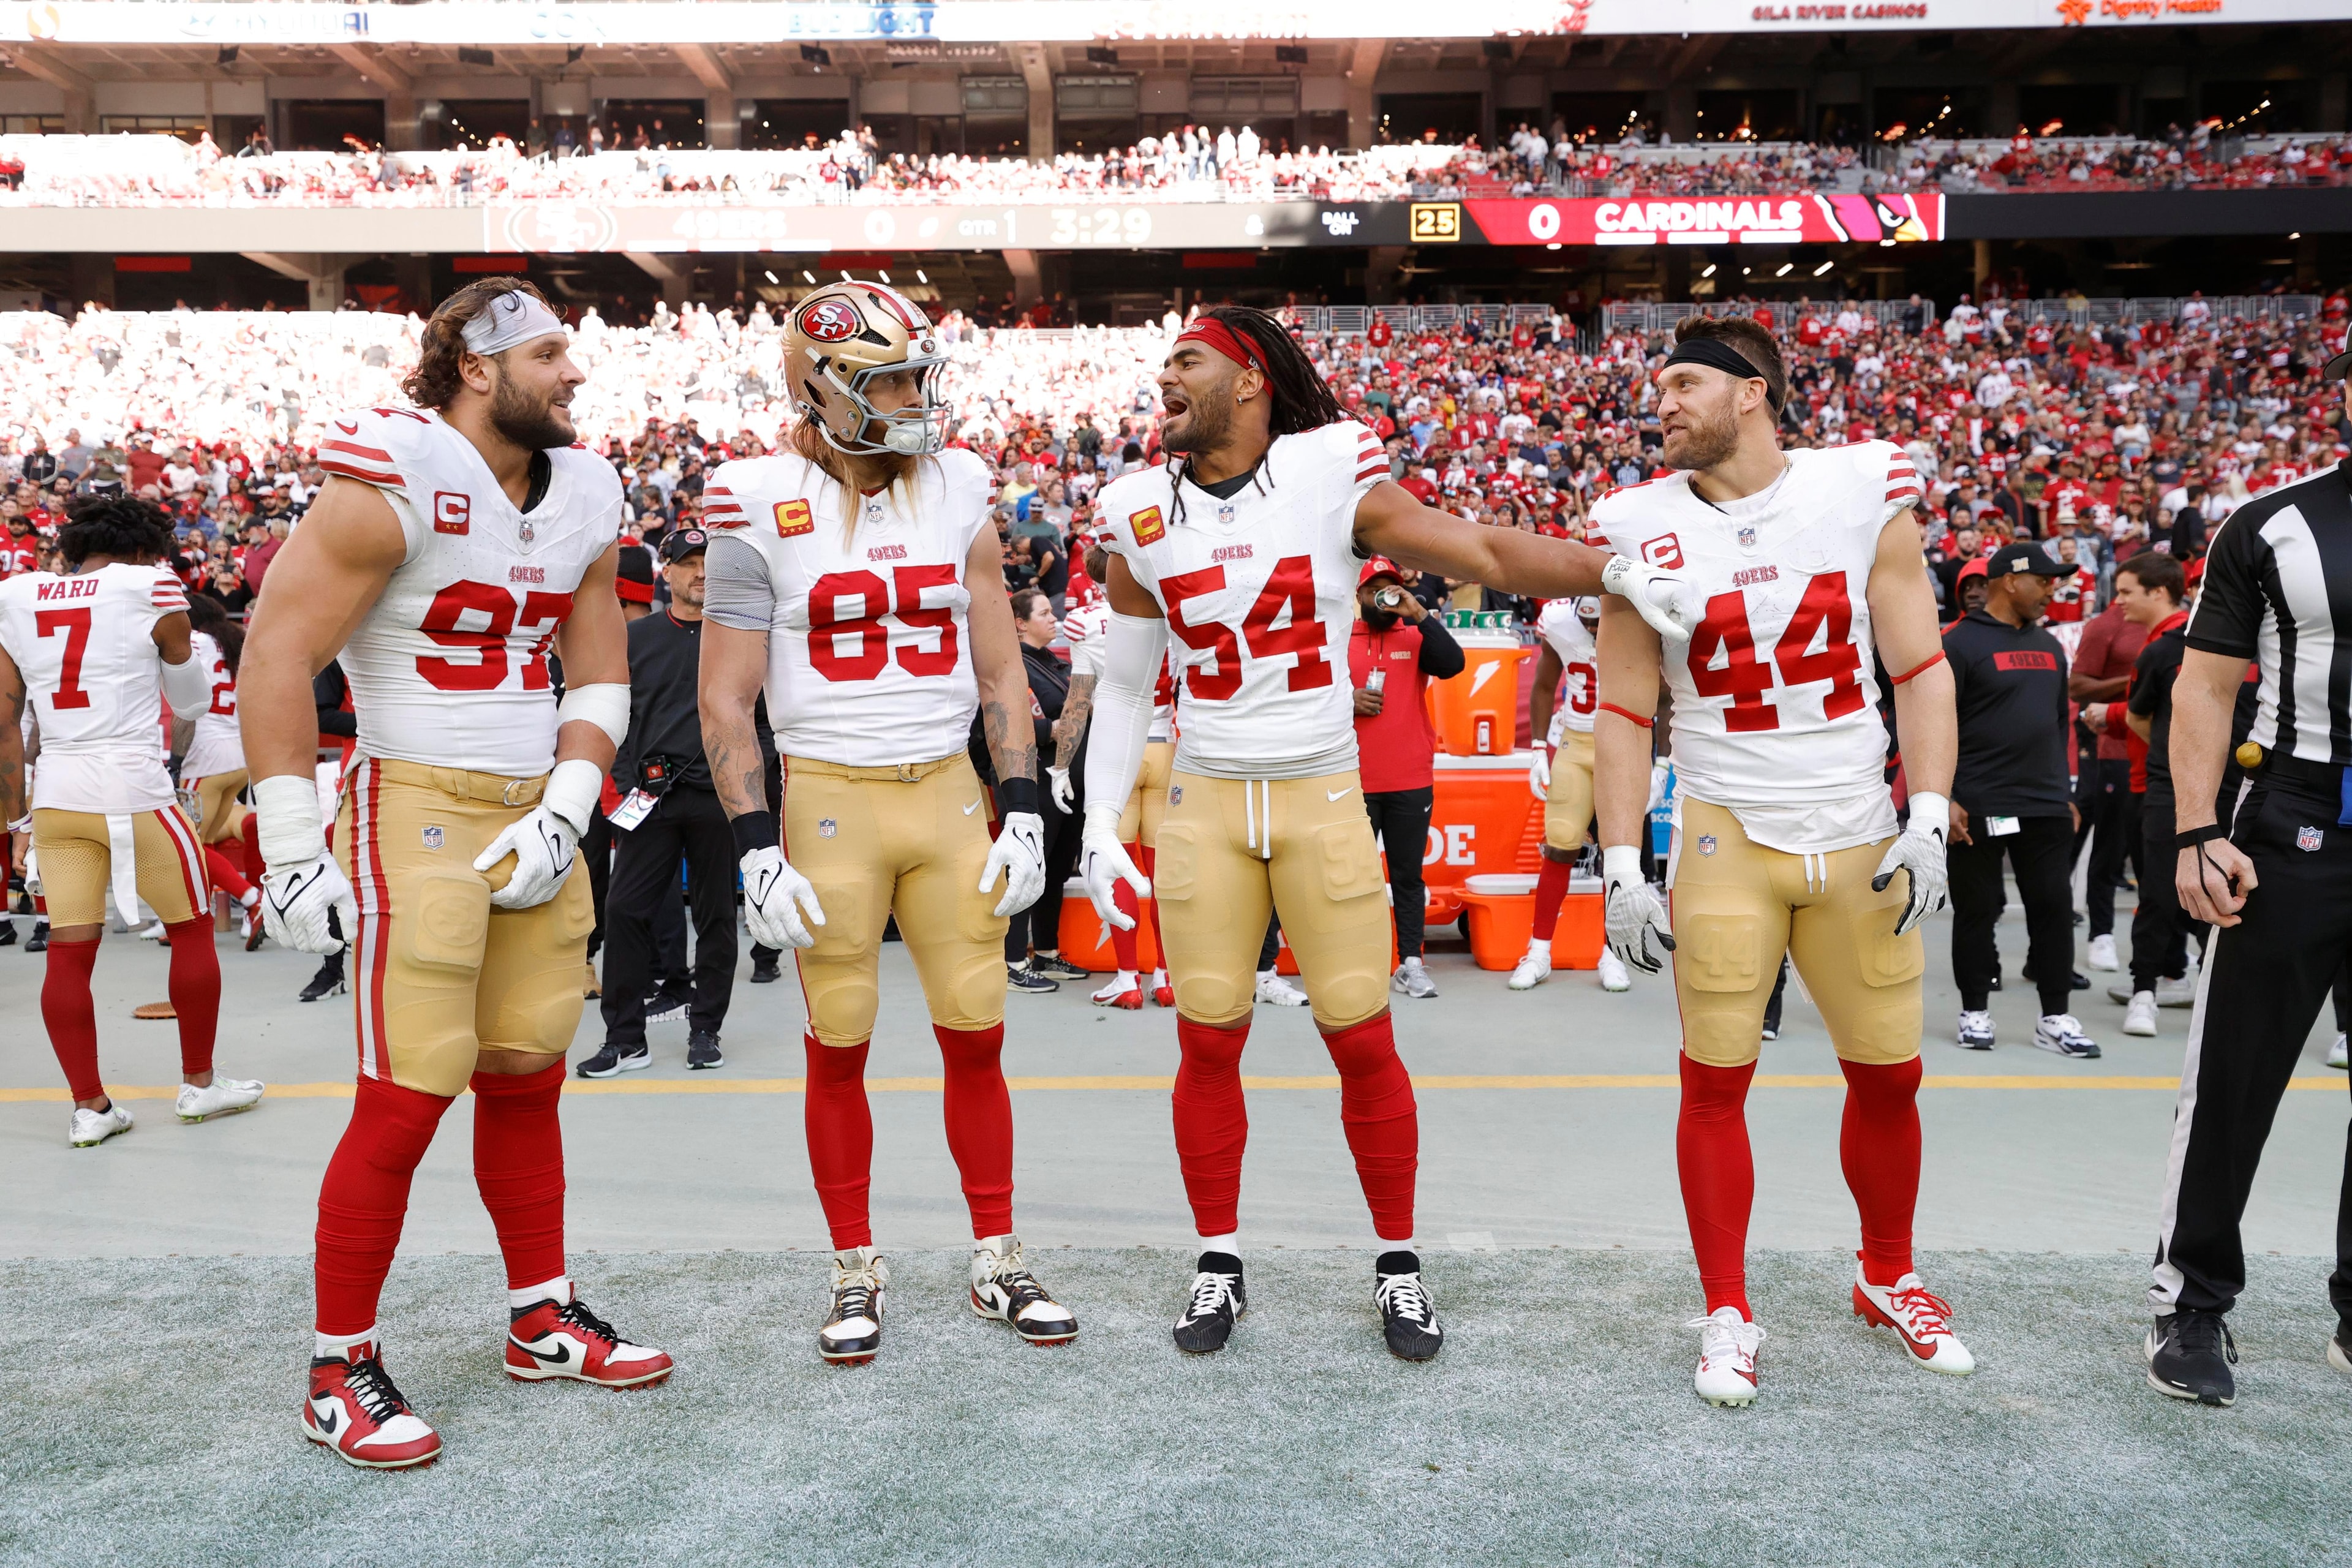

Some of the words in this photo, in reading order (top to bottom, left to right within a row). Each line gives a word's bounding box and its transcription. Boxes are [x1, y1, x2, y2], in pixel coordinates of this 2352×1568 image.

[1752, 6, 1790, 20] GILA
[1796, 4, 1846, 18] RIVER
[1852, 3, 1927, 18] CASINOS
[2100, 0, 2163, 19] Dignity
[852, 9, 933, 34] LIGHT
[672, 209, 786, 238] 49ERS
[1003, 209, 1017, 243] 1
[1050, 208, 1153, 244] 3:29
[1322, 211, 1360, 224] BALL
[1417, 210, 1455, 235] 25
[1528, 203, 1561, 239] 0
[1594, 200, 1802, 230] CARDINALS
[864, 209, 895, 245] 0
[1329, 223, 1352, 235] ON
[437, 493, 467, 522] C
[777, 502, 809, 527] C
[869, 511, 883, 521] NFL
[1220, 513, 1232, 522] NFL
[1133, 509, 1161, 537] C
[1740, 535, 1754, 545] NFL
[867, 544, 907, 561] 49ERS
[1211, 543, 1253, 563] 49ERS
[509, 565, 545, 583] 49ERS
[1732, 564, 1779, 587] 49ERS
[37, 579, 99, 600] WARD
[807, 563, 959, 682] 85
[1158, 554, 1333, 701] 54
[416, 579, 574, 690] 97
[35, 607, 91, 710] 7
[1686, 570, 1866, 733] 44
[2008, 651, 2048, 668] 49ERS
[425, 834, 441, 845] NFL
[821, 824, 835, 835] NFL
[1700, 843, 1715, 853] NFL
[2299, 836, 2319, 848] NFL
